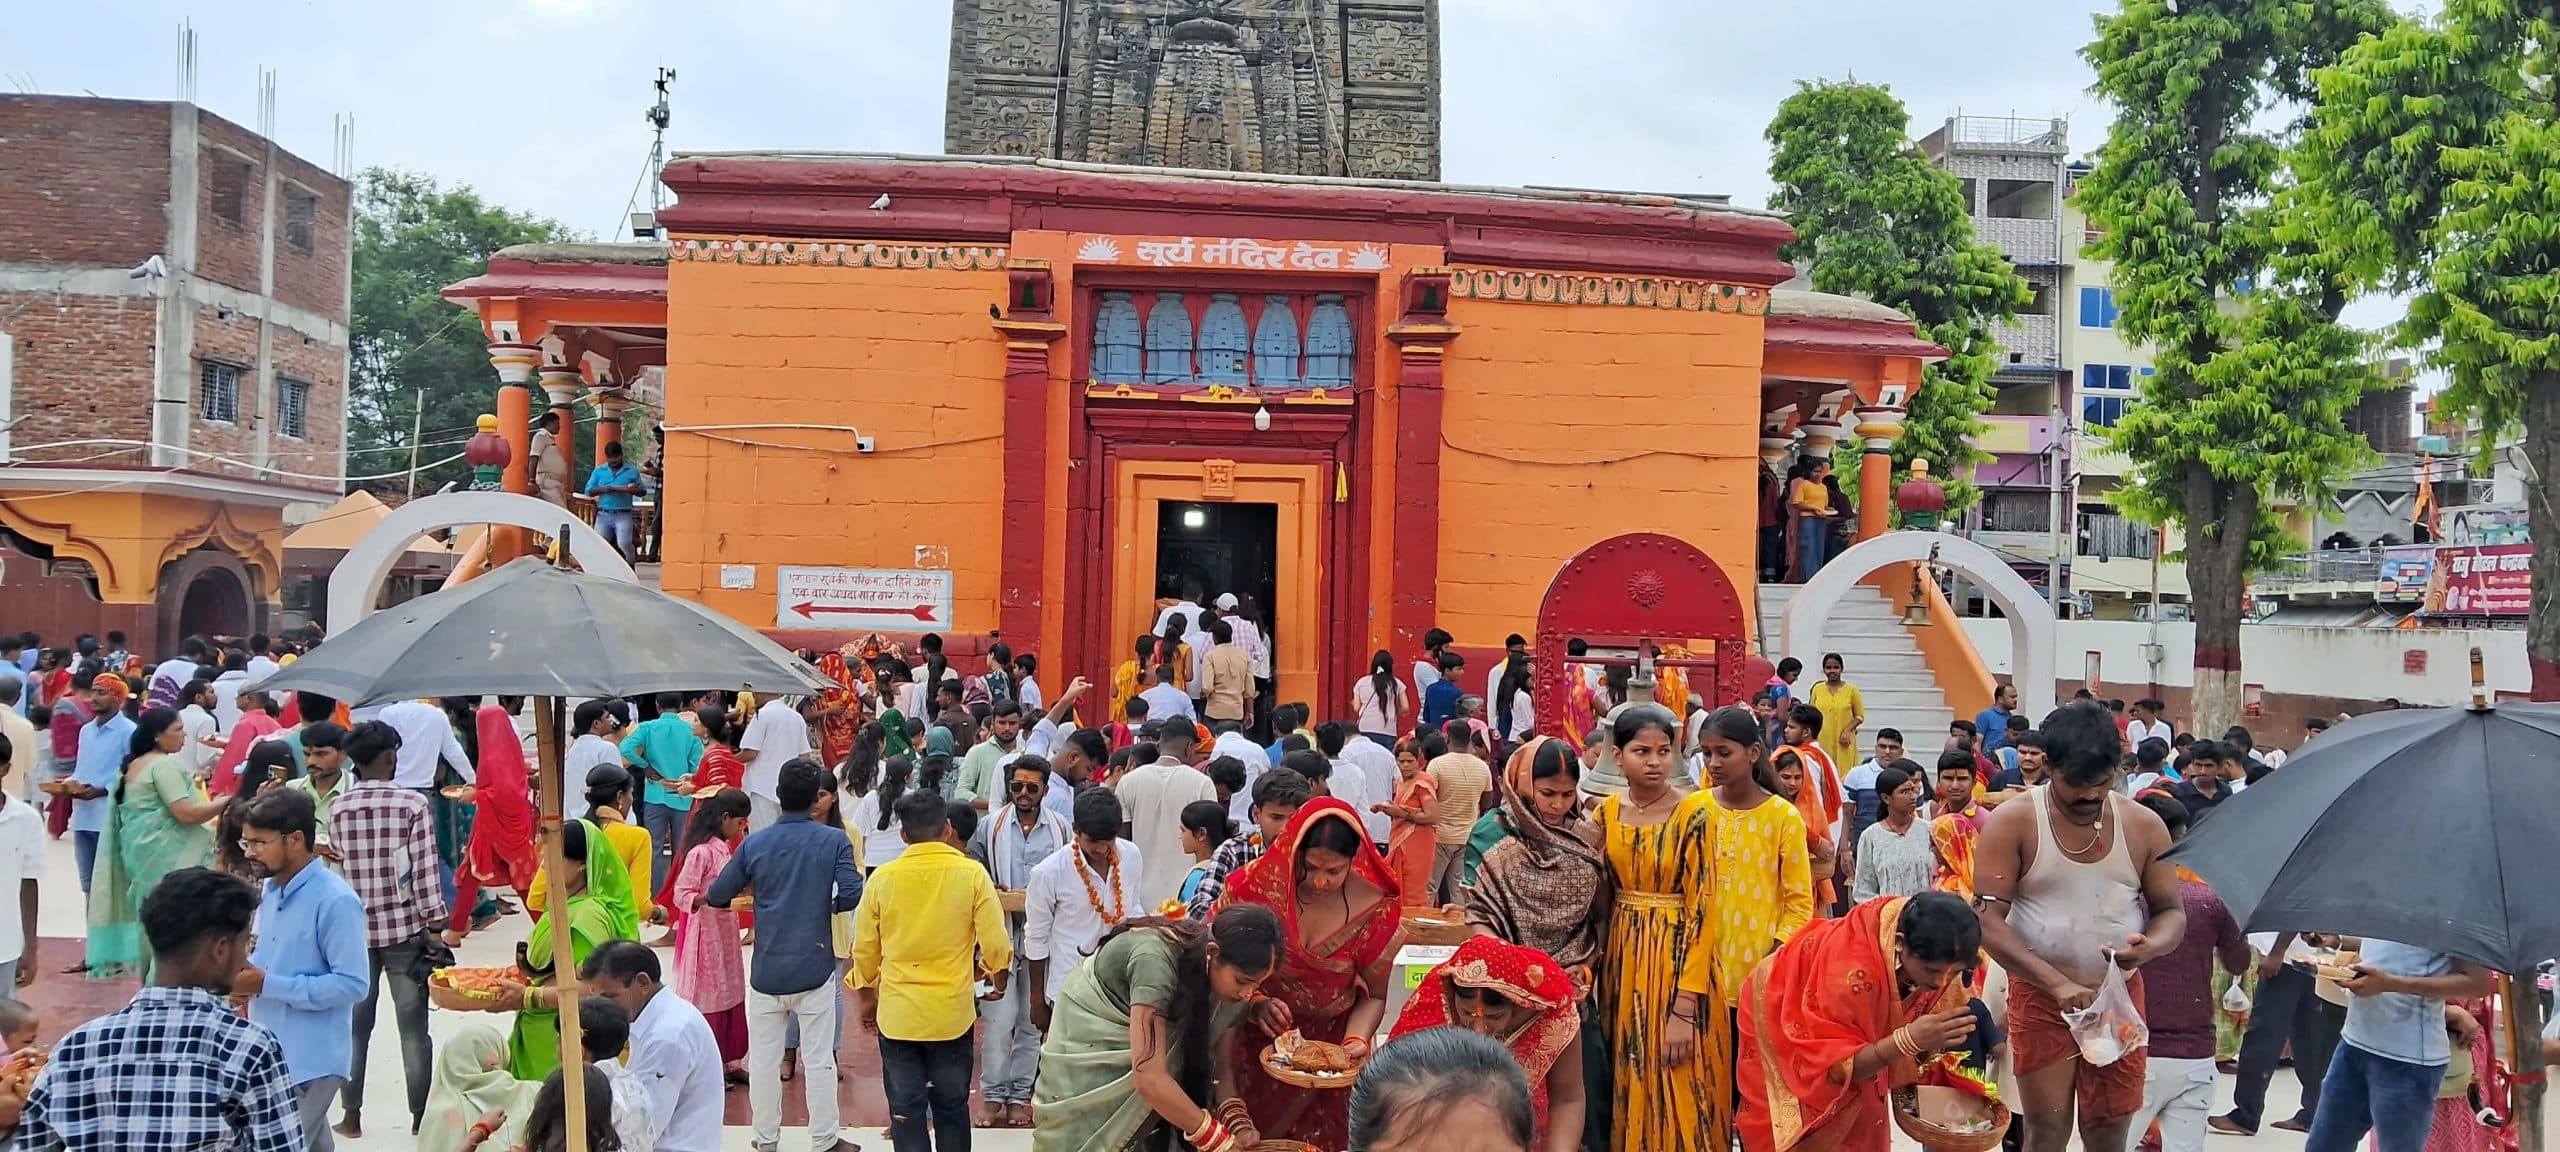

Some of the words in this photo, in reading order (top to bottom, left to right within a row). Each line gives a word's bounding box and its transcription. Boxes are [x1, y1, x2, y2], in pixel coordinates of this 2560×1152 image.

[1137, 237, 1196, 265] सूर्य
[1202, 238, 1288, 268] मंदिर
[1290, 241, 1342, 269] देव
